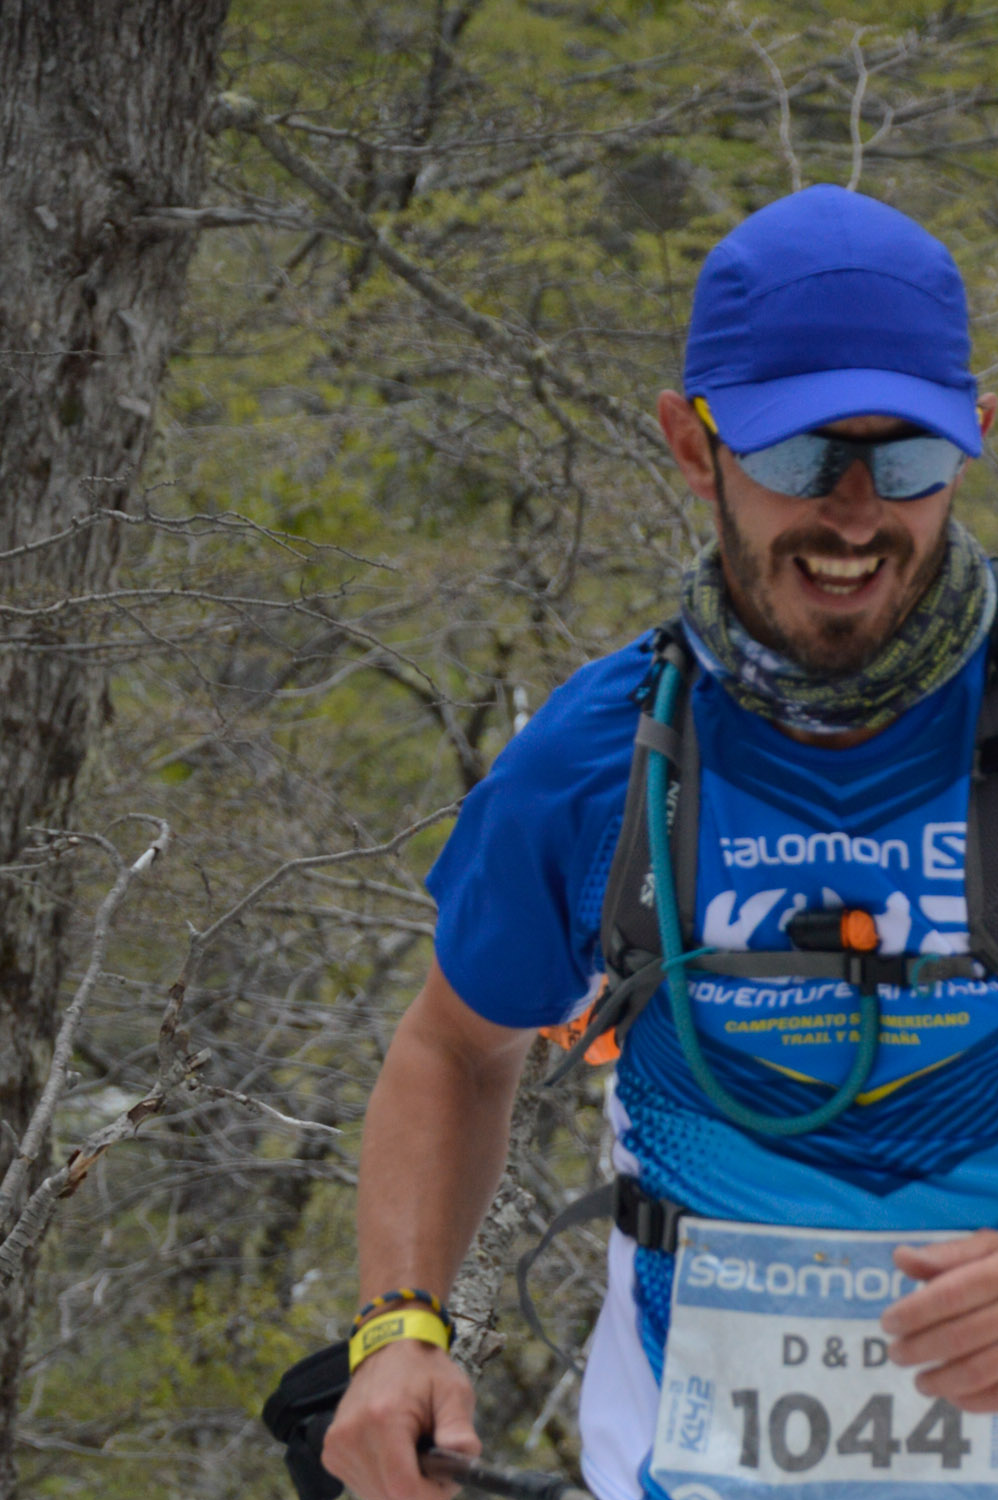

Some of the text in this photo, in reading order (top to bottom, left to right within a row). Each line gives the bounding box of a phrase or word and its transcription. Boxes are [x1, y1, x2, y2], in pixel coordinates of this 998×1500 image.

[726, 1013, 847, 1032] CAMPEONATO
[782, 1032, 831, 1045] TRAIL
[836, 1031, 846, 1043] Y
[782, 1333, 888, 1367] D & D
[731, 1389, 971, 1472] 1044
